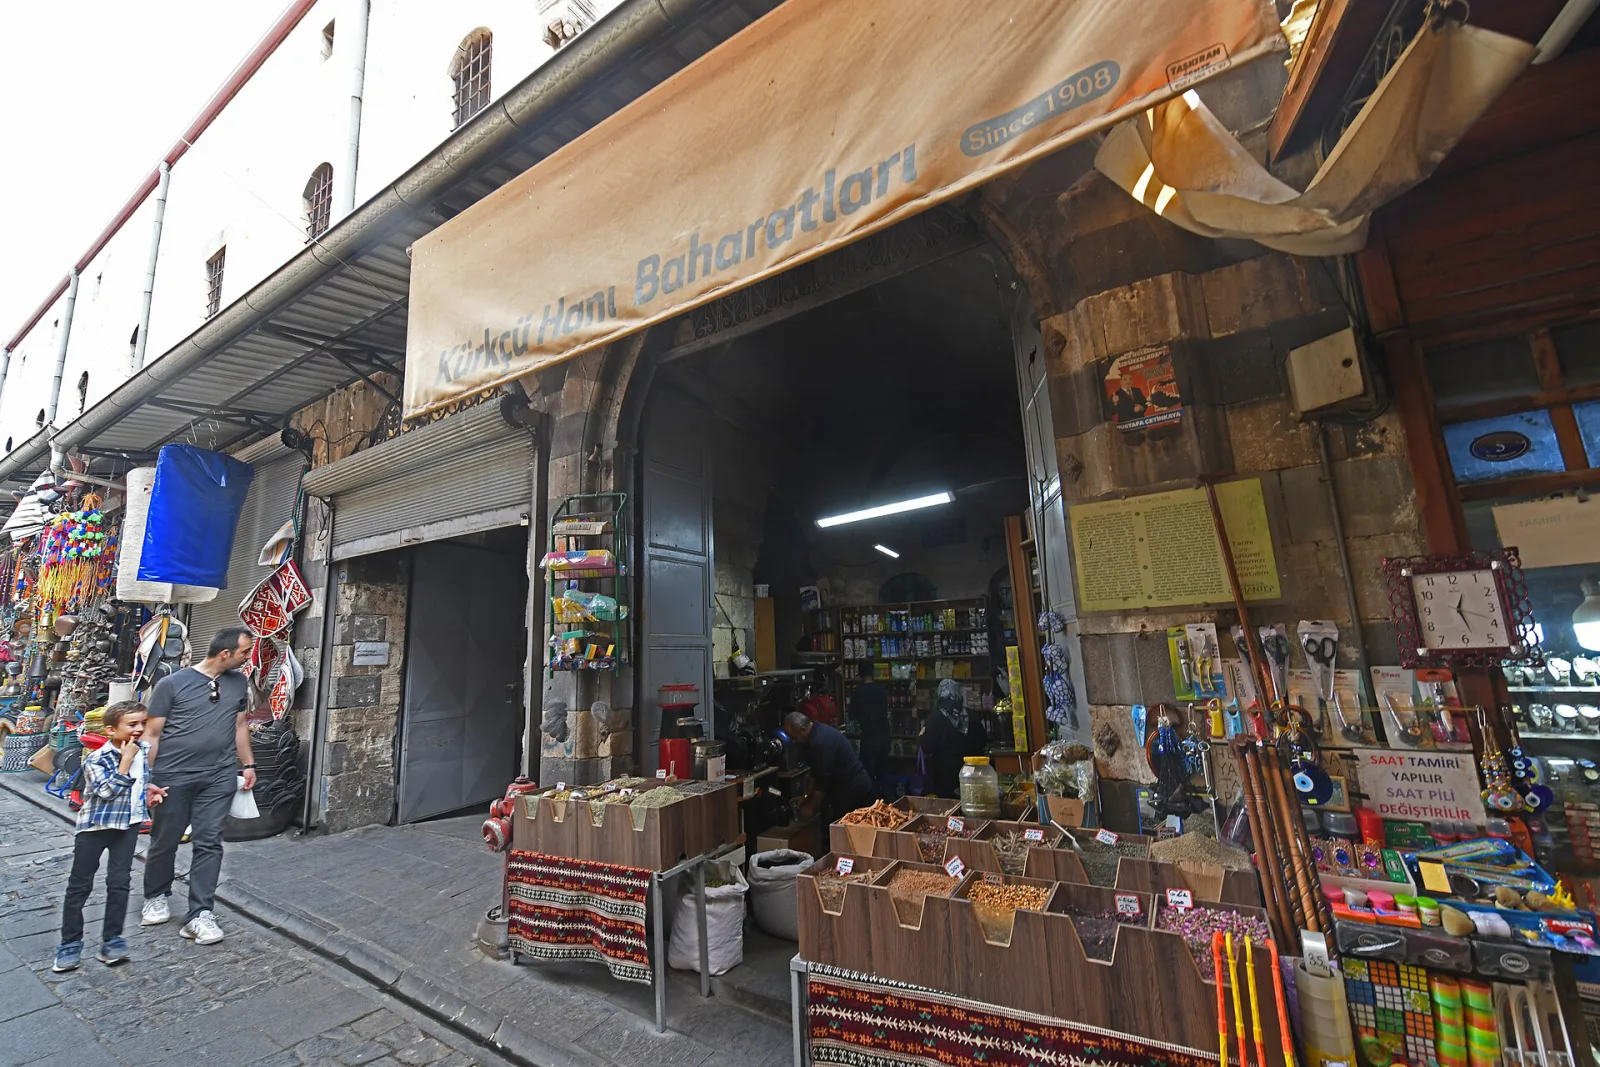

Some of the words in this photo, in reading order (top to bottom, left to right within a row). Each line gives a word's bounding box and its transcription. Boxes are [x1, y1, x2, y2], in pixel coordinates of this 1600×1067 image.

[968, 107, 1035, 152] Since
[1043, 66, 1113, 114] 1908
[436, 318, 529, 388] Kürkçü
[537, 285, 617, 346] Hanı
[633, 144, 917, 307] Baharatları
[1425, 577, 1435, 586] 11
[1446, 575, 1457, 585] 12
[1472, 573, 1478, 583] 1
[1421, 591, 1433, 600] 10
[1484, 587, 1491, 597] 2
[1423, 607, 1431, 616] 9
[1488, 603, 1496, 613] 3
[1427, 622, 1435, 631] 8
[1490, 619, 1498, 628] 4
[1438, 635, 1445, 645] 7
[1461, 634, 1469, 644] 6
[1487, 634, 1494, 644] 5
[1370, 755, 1404, 766] SAAT
[1408, 756, 1460, 769] TAMİRİ
[1391, 772, 1443, 783] YAPILIR
[1387, 787, 1424, 800] SAAT
[1429, 789, 1455, 801] PİLİ
[1380, 802, 1471, 820] DEĞİŞTİRİLİR
[1307, 952, 1324, 967] 35
